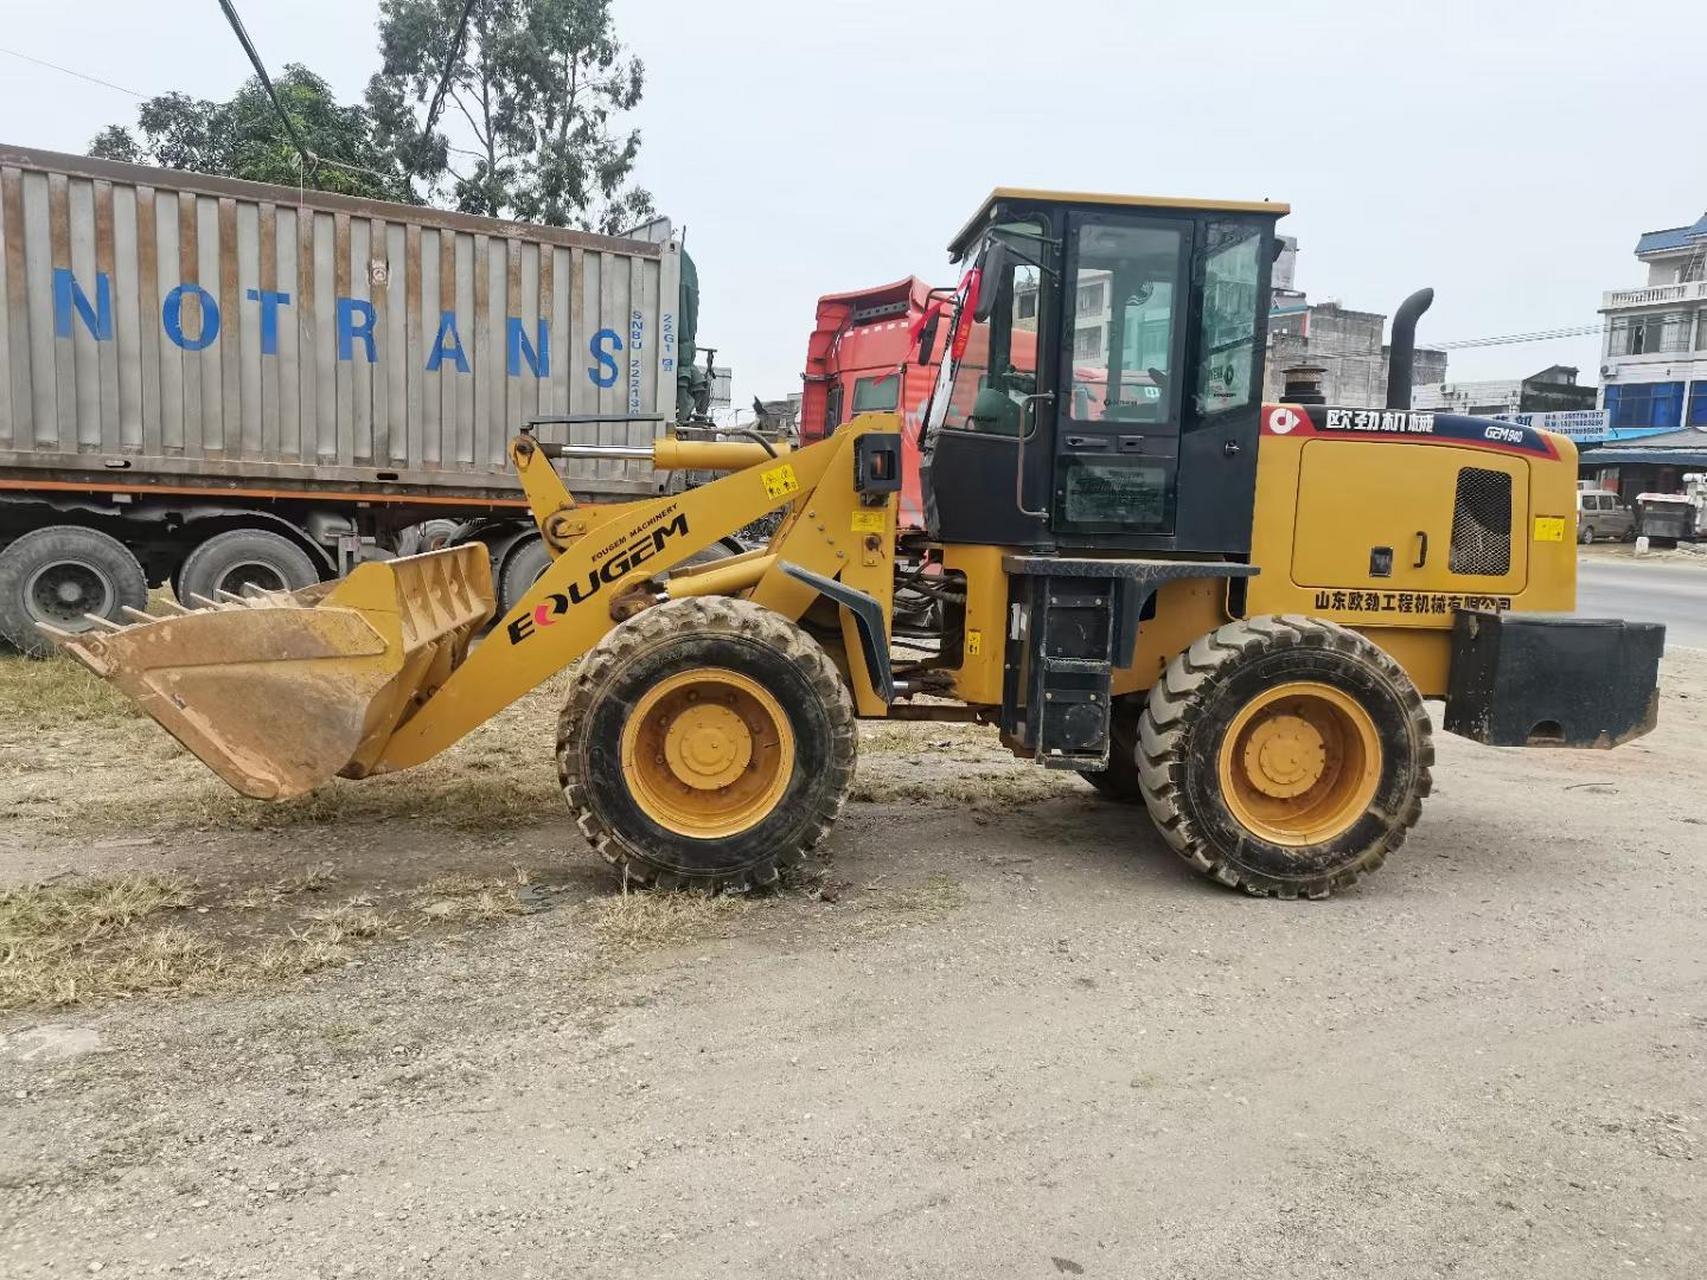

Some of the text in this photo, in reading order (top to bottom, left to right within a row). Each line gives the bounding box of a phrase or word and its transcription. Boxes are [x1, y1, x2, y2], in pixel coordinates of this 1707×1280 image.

[52, 267, 623, 388] NOTRANS
[631, 310, 644, 350] SNBU
[663, 313, 675, 352] 22G1
[1325, 408, 1435, 433] 欧劲机械
[629, 502, 679, 539] MACHINERY
[1315, 590, 1512, 615] 山东欧劲工程机械有限公司
